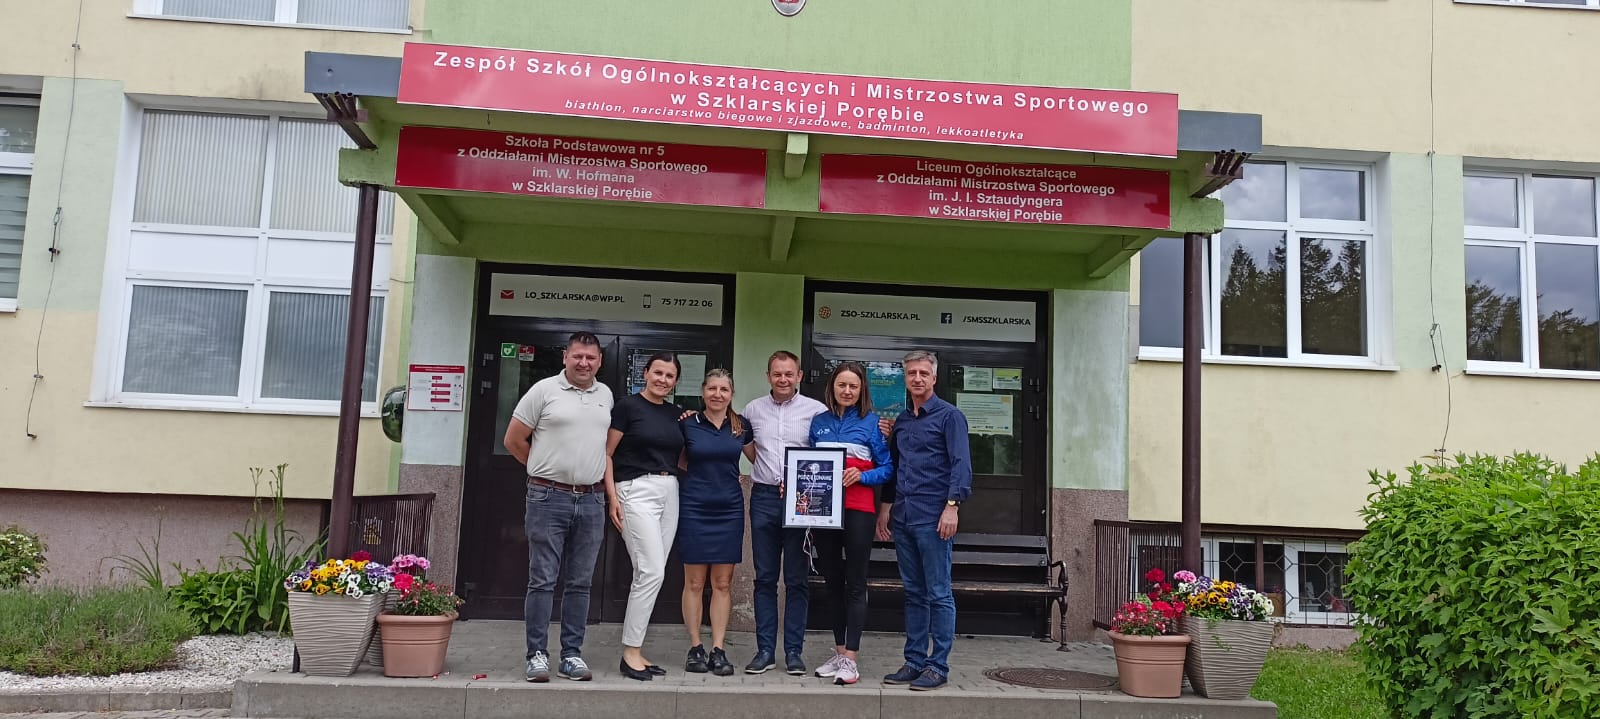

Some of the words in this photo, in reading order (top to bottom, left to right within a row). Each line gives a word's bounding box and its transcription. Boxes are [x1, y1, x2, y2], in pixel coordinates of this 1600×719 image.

[434, 51, 516, 73] Zespół
[527, 57, 592, 78] Szkół
[602, 64, 839, 96] Ogólnokształcących
[851, 83, 856, 97] i
[867, 84, 1003, 107] Mistrzostwa
[1014, 93, 1149, 117] Sportowego
[671, 93, 686, 105] w
[697, 91, 826, 119] Szklarskiej
[837, 102, 924, 123] Porębie
[565, 100, 626, 114] biathlon,
[632, 104, 712, 119] narciarstwo
[718, 109, 772, 124] biegowe
[777, 114, 782, 123] i
[787, 115, 851, 129] zjazdowe,
[858, 120, 931, 135] badminton,
[936, 125, 1024, 142] lekkoatletyka
[505, 135, 549, 149] Szkoła
[554, 139, 635, 154] Podstawowa
[639, 146, 652, 155] nr
[657, 145, 665, 156] 5
[458, 149, 464, 157] z
[469, 147, 543, 163] Oddziałami
[548, 153, 626, 168] Mistrzostwa
[630, 158, 707, 173] Sportowego
[917, 161, 962, 174] Liceum
[533, 166, 551, 178] im.
[555, 167, 572, 180] W.
[576, 169, 634, 183] Hofmana
[877, 175, 884, 183] z
[888, 173, 957, 188] Oddziałami
[961, 178, 1035, 192] Mistrzostwa
[1040, 182, 1115, 196] Sportowego
[512, 182, 524, 191] w
[527, 180, 599, 198] Szklarskiej
[603, 185, 652, 200] Porębie
[929, 190, 947, 202] im.
[951, 191, 963, 202] J.
[967, 192, 973, 202] I.
[977, 193, 1063, 209] Sztaudyngera
[929, 206, 939, 215] w
[943, 204, 1010, 220] Szklarskiej
[1014, 209, 1062, 222] Porębie
[525, 292, 625, 302] LO_SZKLARSKA@WP.PL
[841, 310, 920, 320] ZSO-SZKLARSKA.PL
